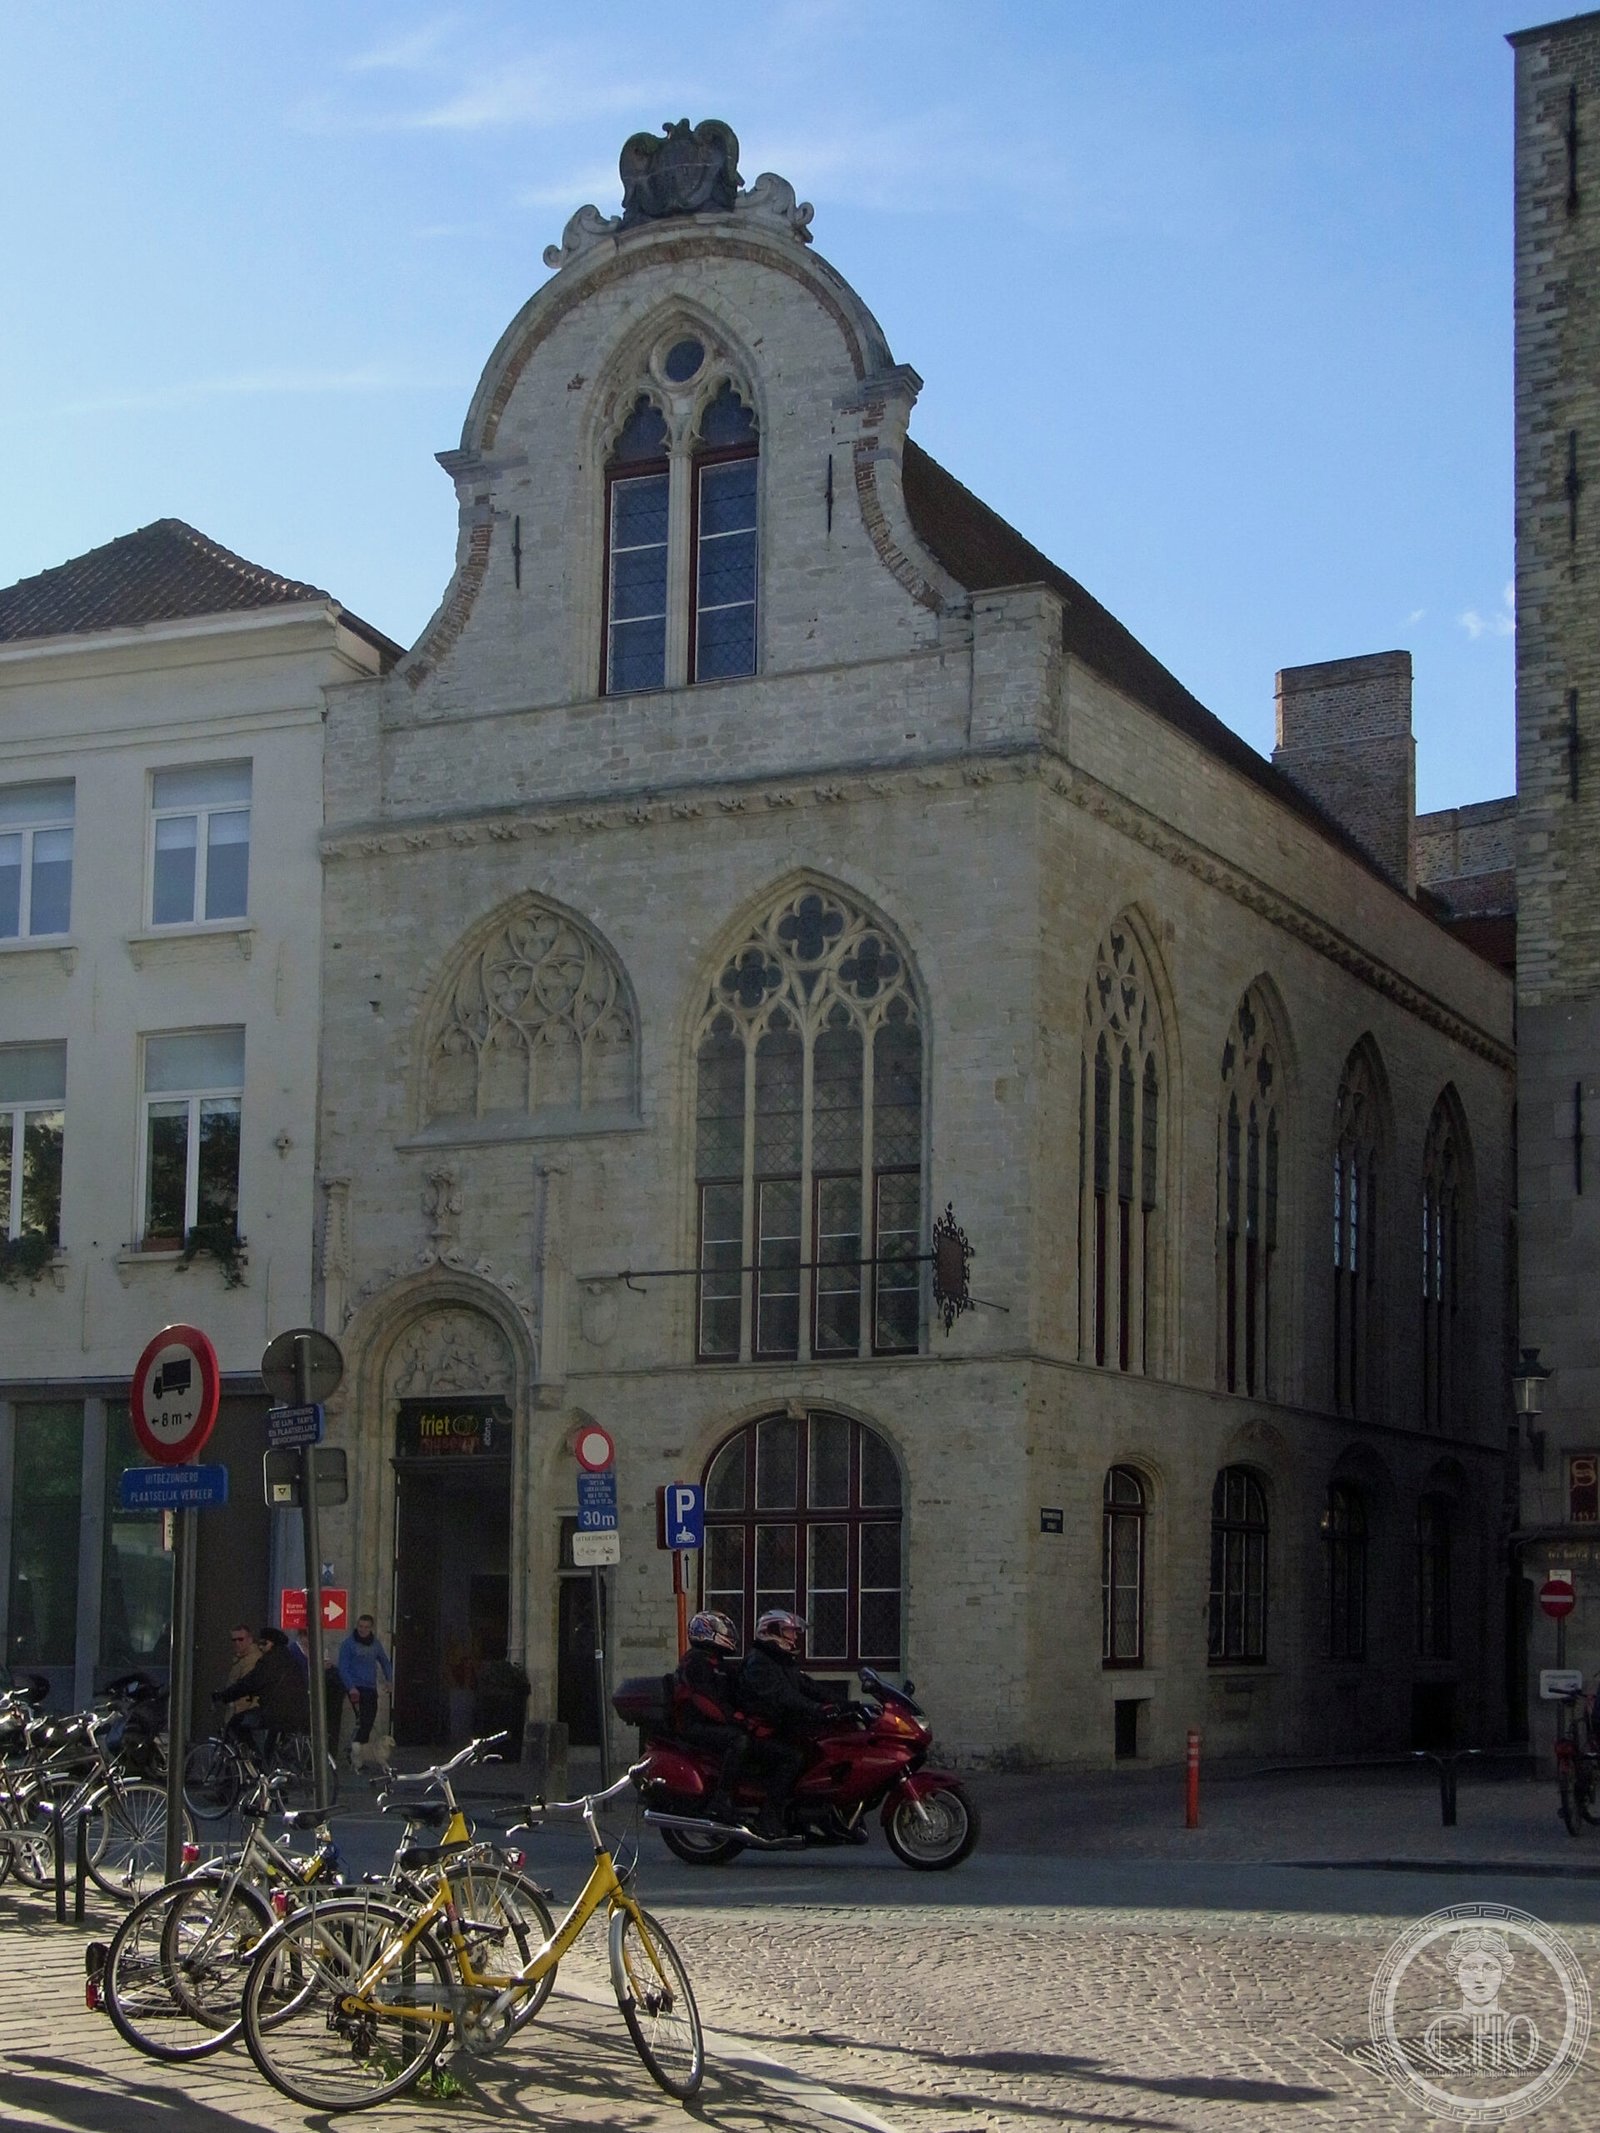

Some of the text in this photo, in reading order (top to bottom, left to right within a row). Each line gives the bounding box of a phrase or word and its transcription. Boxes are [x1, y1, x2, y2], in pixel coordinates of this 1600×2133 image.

[162, 1412, 182, 1427] 8 m
[420, 1414, 450, 1437] friet
[145, 1471, 199, 1485] UITGEZONDERD
[130, 1488, 213, 1502] PLAATSELIJK VERKEER
[676, 1489, 695, 1523] P
